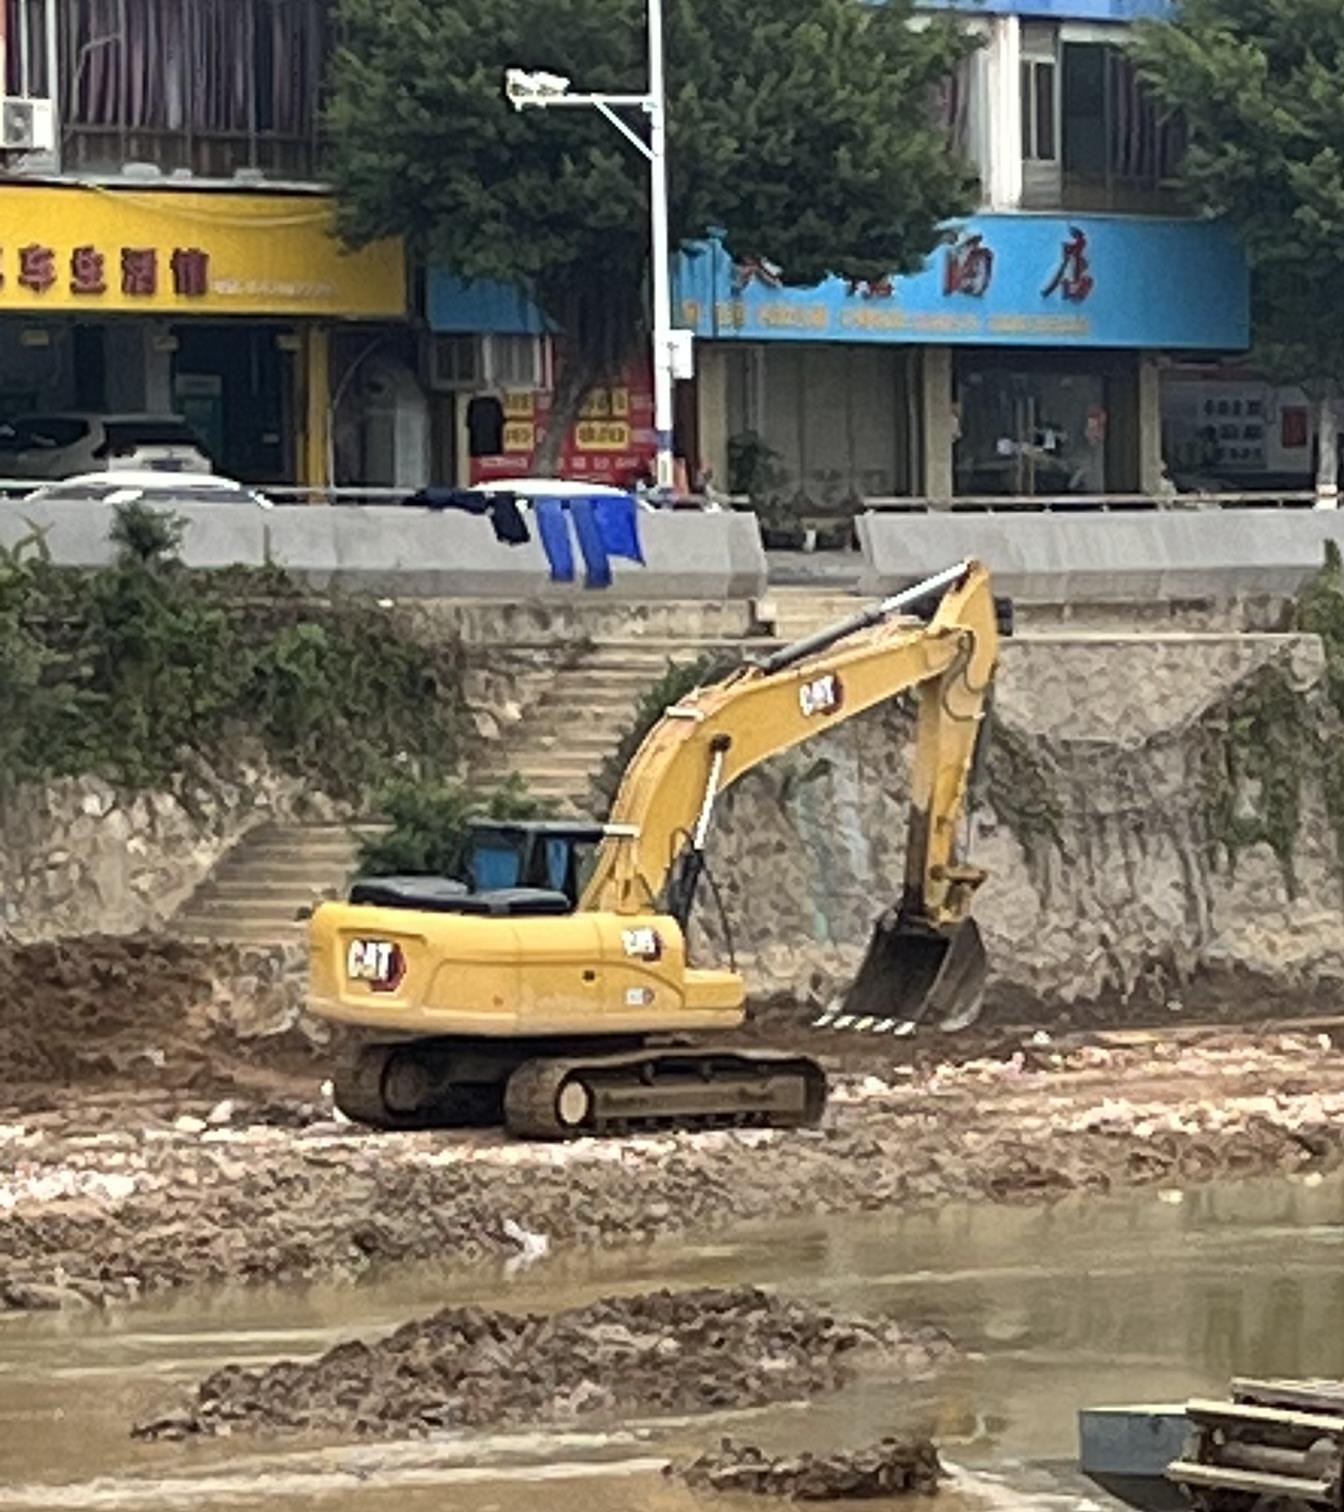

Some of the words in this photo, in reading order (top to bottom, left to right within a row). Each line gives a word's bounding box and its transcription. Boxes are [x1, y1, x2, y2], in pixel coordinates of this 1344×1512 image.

[0, 243, 210, 296] 车生活馆
[799, 674, 834, 716] CAT
[347, 939, 395, 981] CAT
